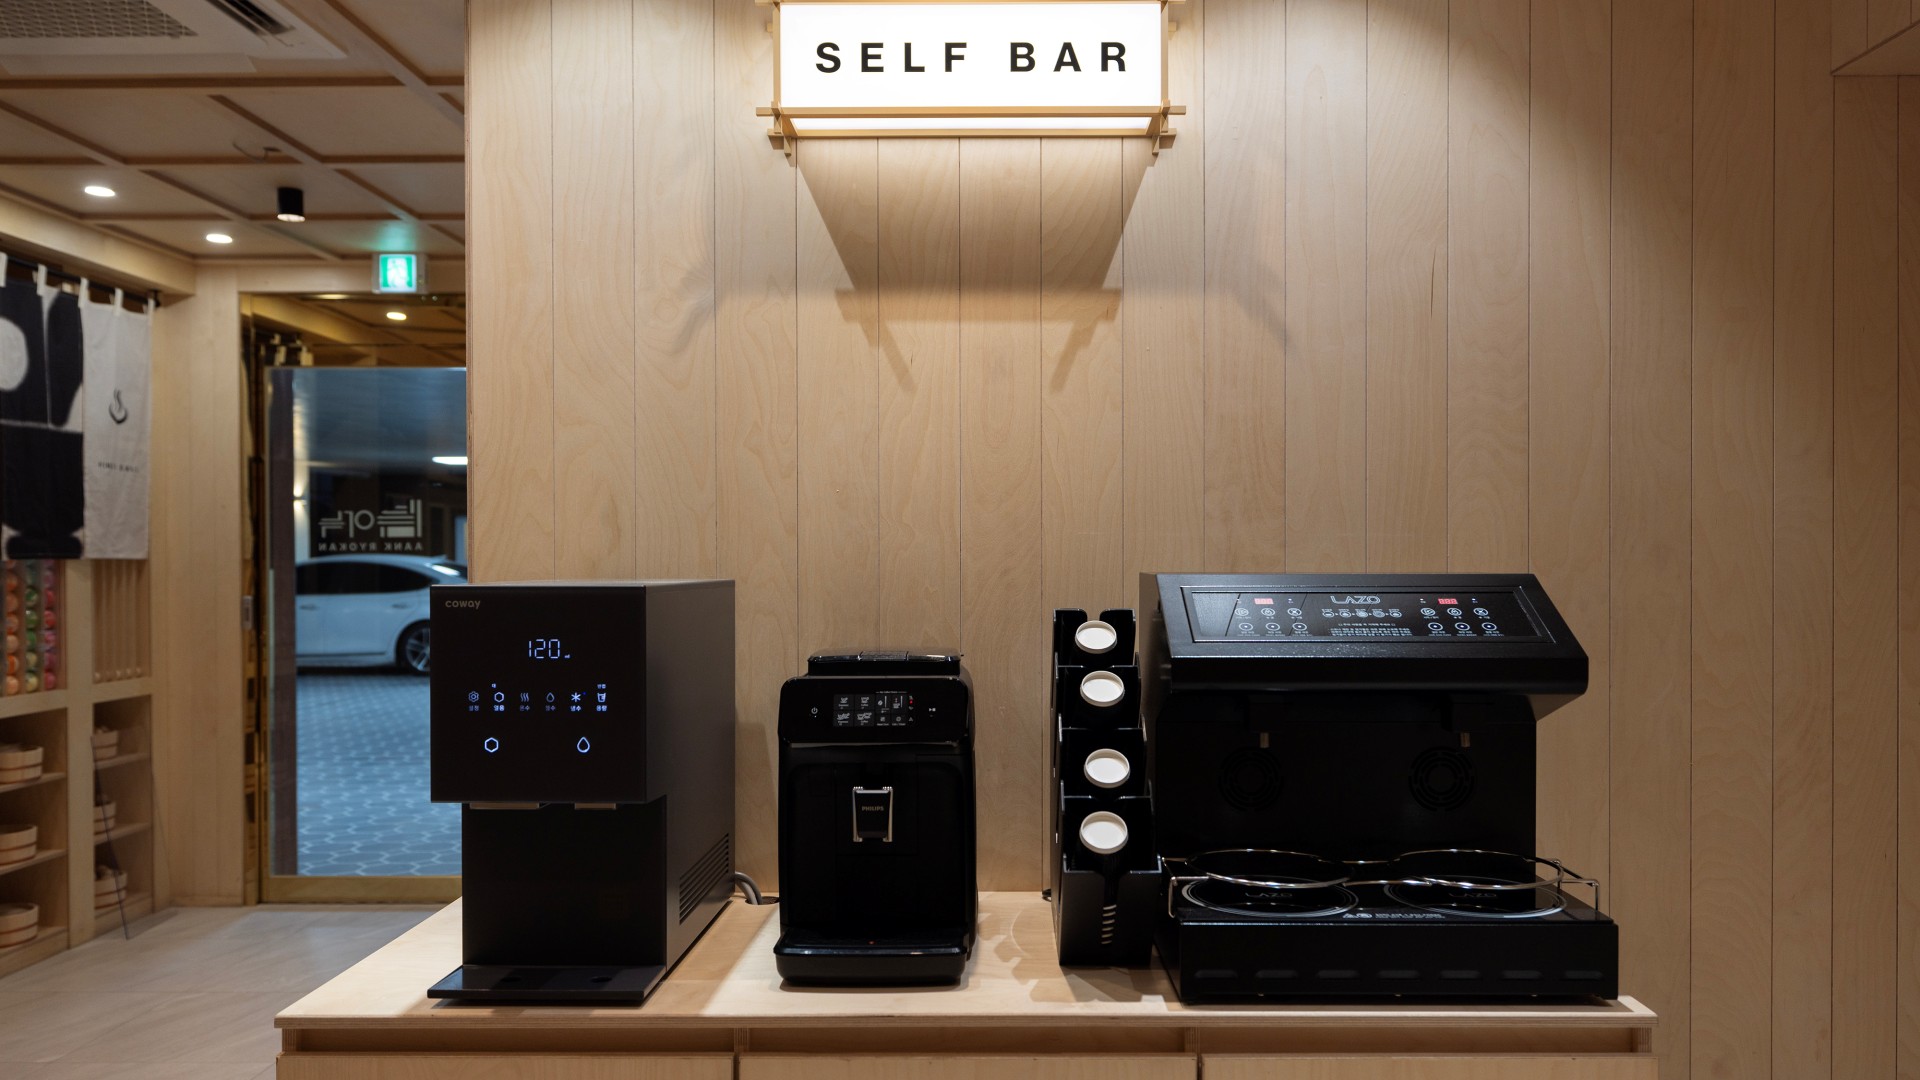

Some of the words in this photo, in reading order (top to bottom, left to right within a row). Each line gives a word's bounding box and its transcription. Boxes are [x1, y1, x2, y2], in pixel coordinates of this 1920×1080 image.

[815, 42, 967, 73] SELF
[1009, 42, 1127, 72] BAR
[445, 600, 481, 609] coway
[1330, 595, 1381, 605] LAZO
[528, 638, 561, 659] 120
